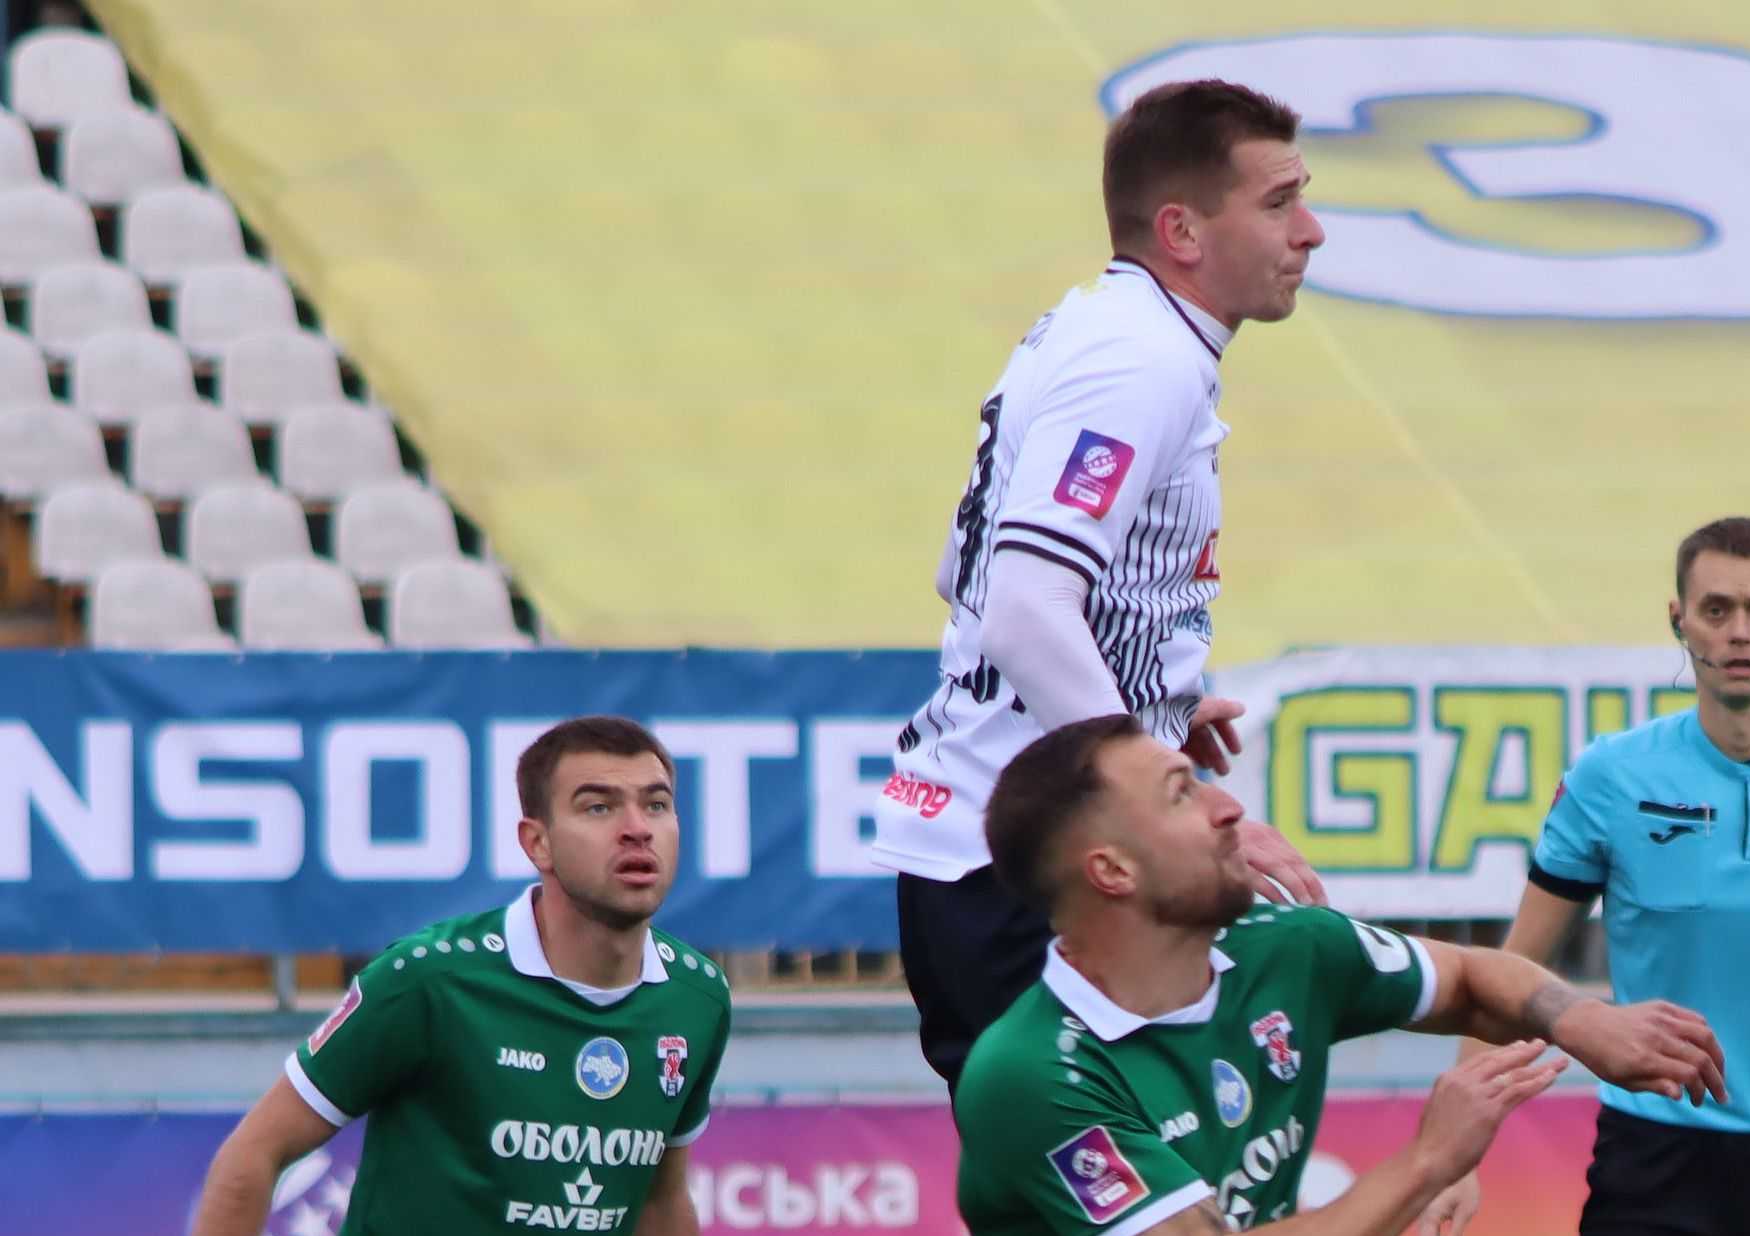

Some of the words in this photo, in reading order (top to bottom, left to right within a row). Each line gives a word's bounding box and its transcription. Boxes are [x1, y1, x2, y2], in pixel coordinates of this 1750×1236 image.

[0, 719, 900, 882] NSOTE
[497, 1047, 546, 1071] JAKO
[491, 1120, 664, 1166] ОБОЛОНЬ
[506, 1201, 628, 1231] FAVBET
